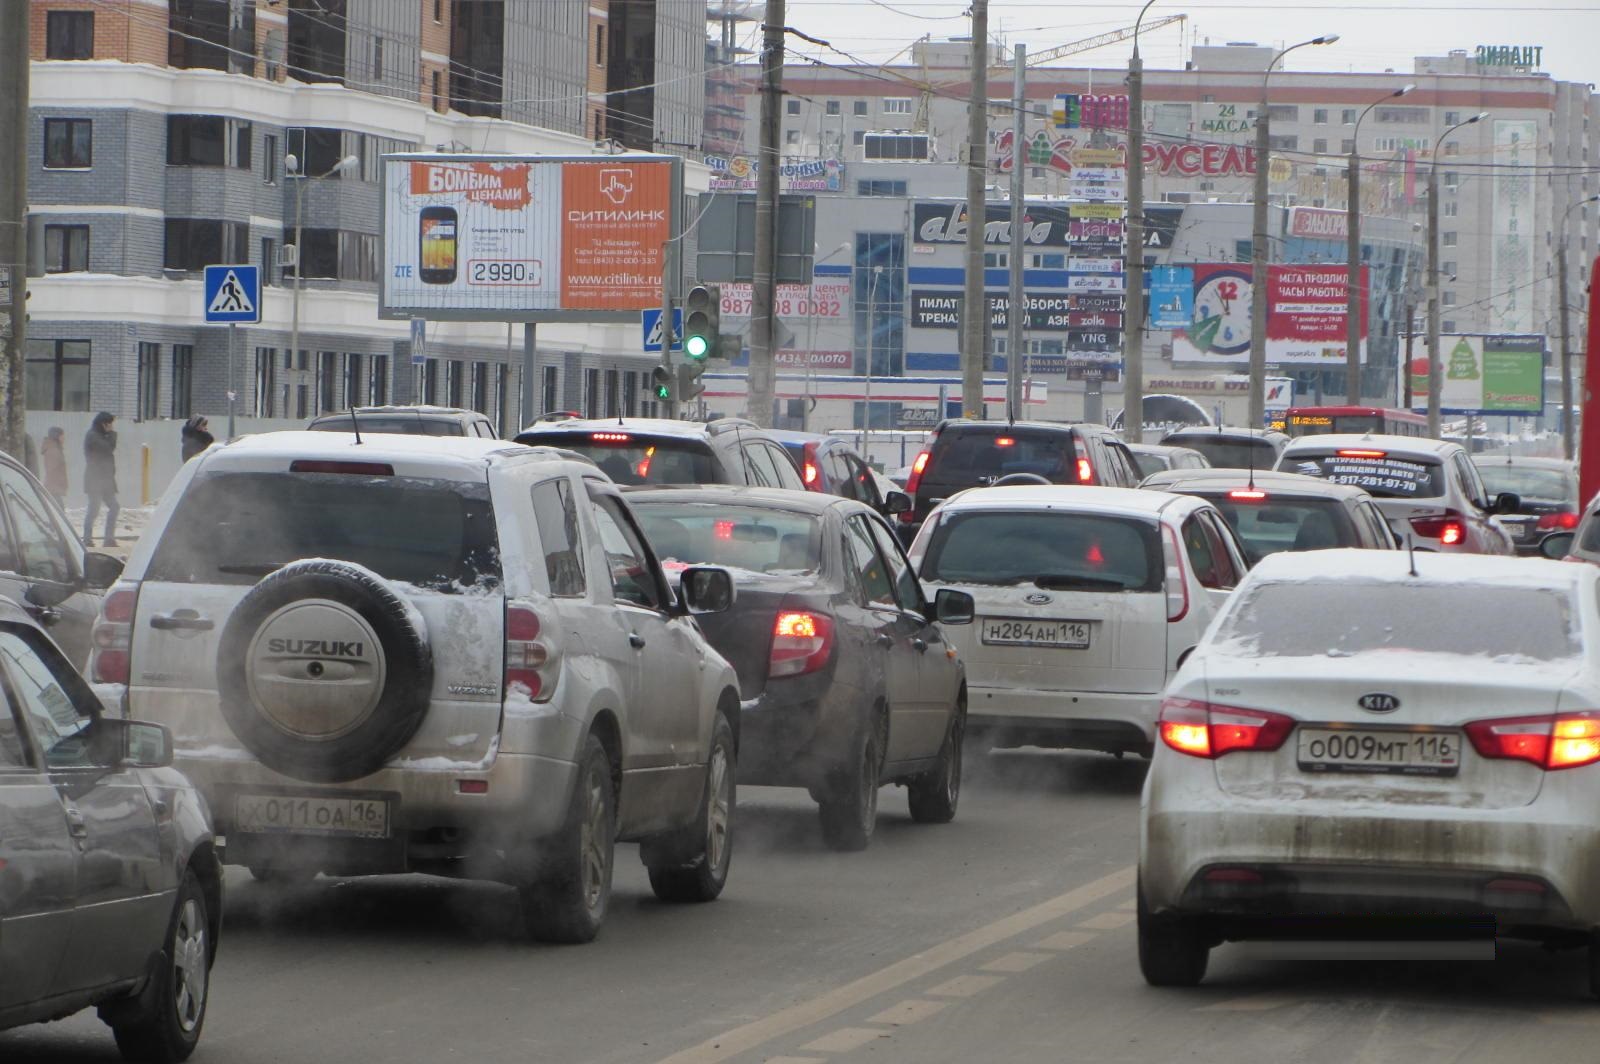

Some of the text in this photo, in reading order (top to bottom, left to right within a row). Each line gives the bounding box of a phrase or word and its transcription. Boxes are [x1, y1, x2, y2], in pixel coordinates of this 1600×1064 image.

[1476, 45, 1543, 66] ЗИЛАНТ
[1218, 104, 1236, 117] 24
[428, 166, 502, 192] БОМБИМ
[471, 188, 522, 201] ЦЕНАМИ
[568, 210, 665, 221] СИТИЛИНК
[394, 265, 412, 278] ZTE
[568, 273, 662, 285] www.citilink.ru
[1304, 273, 1349, 285] ПРОДЛИЛ
[1217, 281, 1238, 300] 12
[1279, 286, 1305, 297] ЧАСЫ
[1081, 315, 1105, 326] zolla
[1081, 333, 1107, 343] YNG
[1328, 475, 1417, 491] 8-917-281-97-70
[1060, 624, 1084, 637] 116
[269, 638, 364, 656] SUZUKI
[1363, 696, 1395, 708] KIA
[1414, 737, 1450, 756] 116
[354, 802, 377, 821] 16
